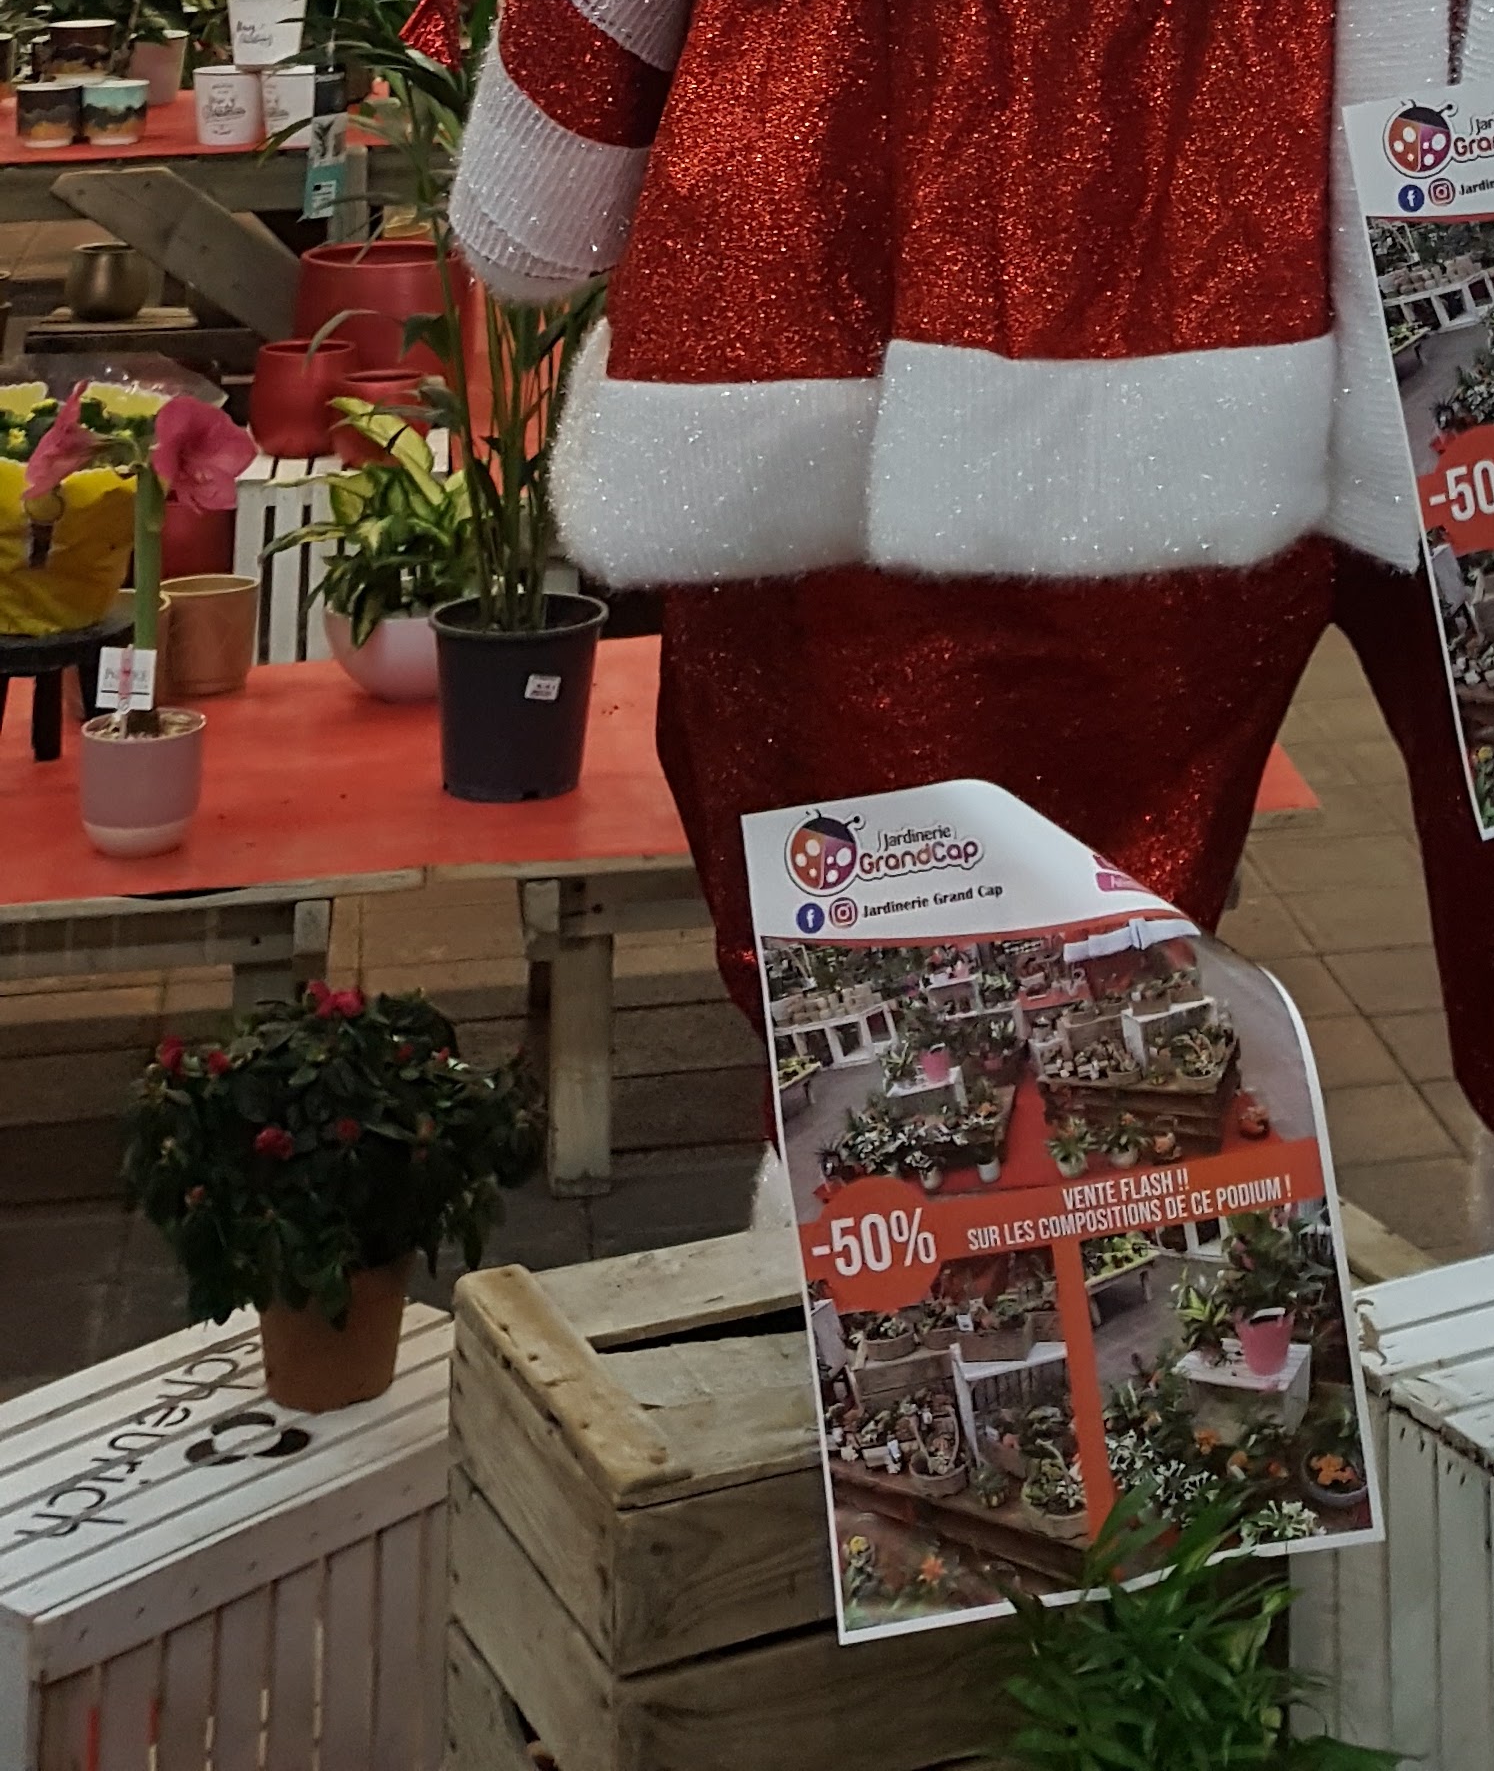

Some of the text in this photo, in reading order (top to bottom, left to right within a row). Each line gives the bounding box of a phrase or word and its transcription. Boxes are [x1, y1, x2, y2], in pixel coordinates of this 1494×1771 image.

[884, 824, 951, 851] Jardinerie
[859, 840, 979, 875] GrandCap
[863, 884, 1003, 918] Jardinerie Grand Cap
[1062, 1180, 1118, 1210] VENTE
[1119, 1170, 1174, 1201] FLASH
[967, 1225, 1000, 1251] SUR
[1003, 1220, 1036, 1245] LES
[1038, 1201, 1162, 1240] COMPOSITIONS
[1164, 1194, 1188, 1220] DE
[1190, 1190, 1213, 1215] CE
[1216, 1176, 1281, 1211] PODIUM
[811, 1208, 937, 1276] -50%
